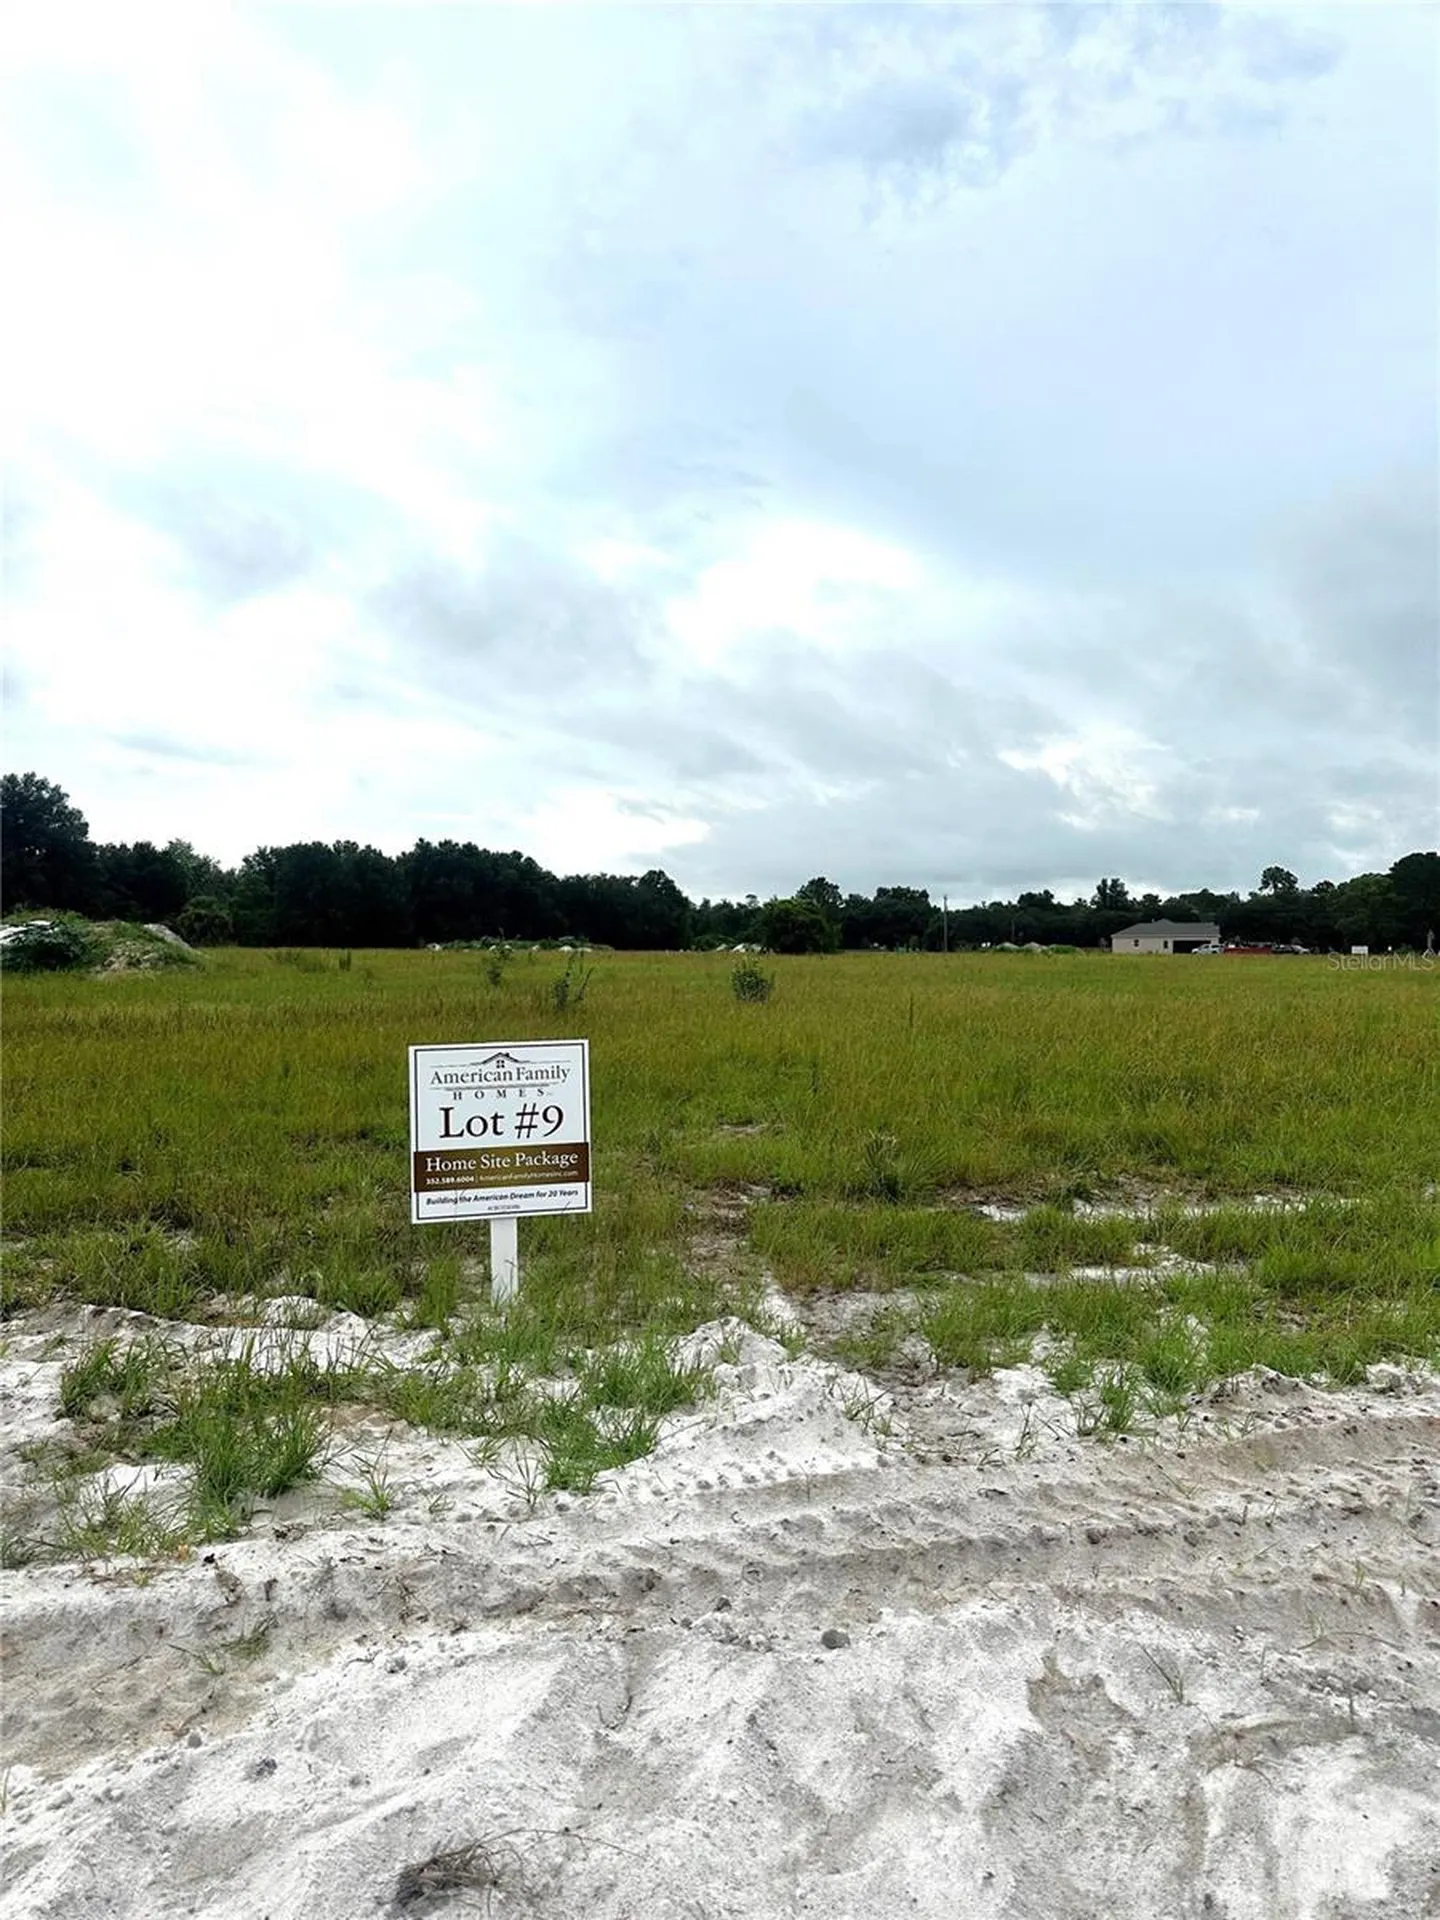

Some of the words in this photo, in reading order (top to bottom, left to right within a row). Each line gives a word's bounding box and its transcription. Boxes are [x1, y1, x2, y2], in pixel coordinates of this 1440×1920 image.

[430, 1067, 513, 1085] American
[516, 1065, 571, 1084] Family
[453, 1088, 545, 1100] HOMES
[439, 1106, 505, 1139] Lot
[514, 1103, 564, 1139] #9
[426, 1157, 477, 1172] Home
[480, 1154, 511, 1169] Site
[515, 1151, 579, 1170] Package
[426, 1196, 459, 1206] Building
[459, 1195, 472, 1203] the
[473, 1193, 509, 1203] American
[510, 1191, 535, 1201] Dream
[536, 1190, 548, 1199] for
[548, 1190, 558, 1198] 20
[558, 1188, 579, 1198] Years
